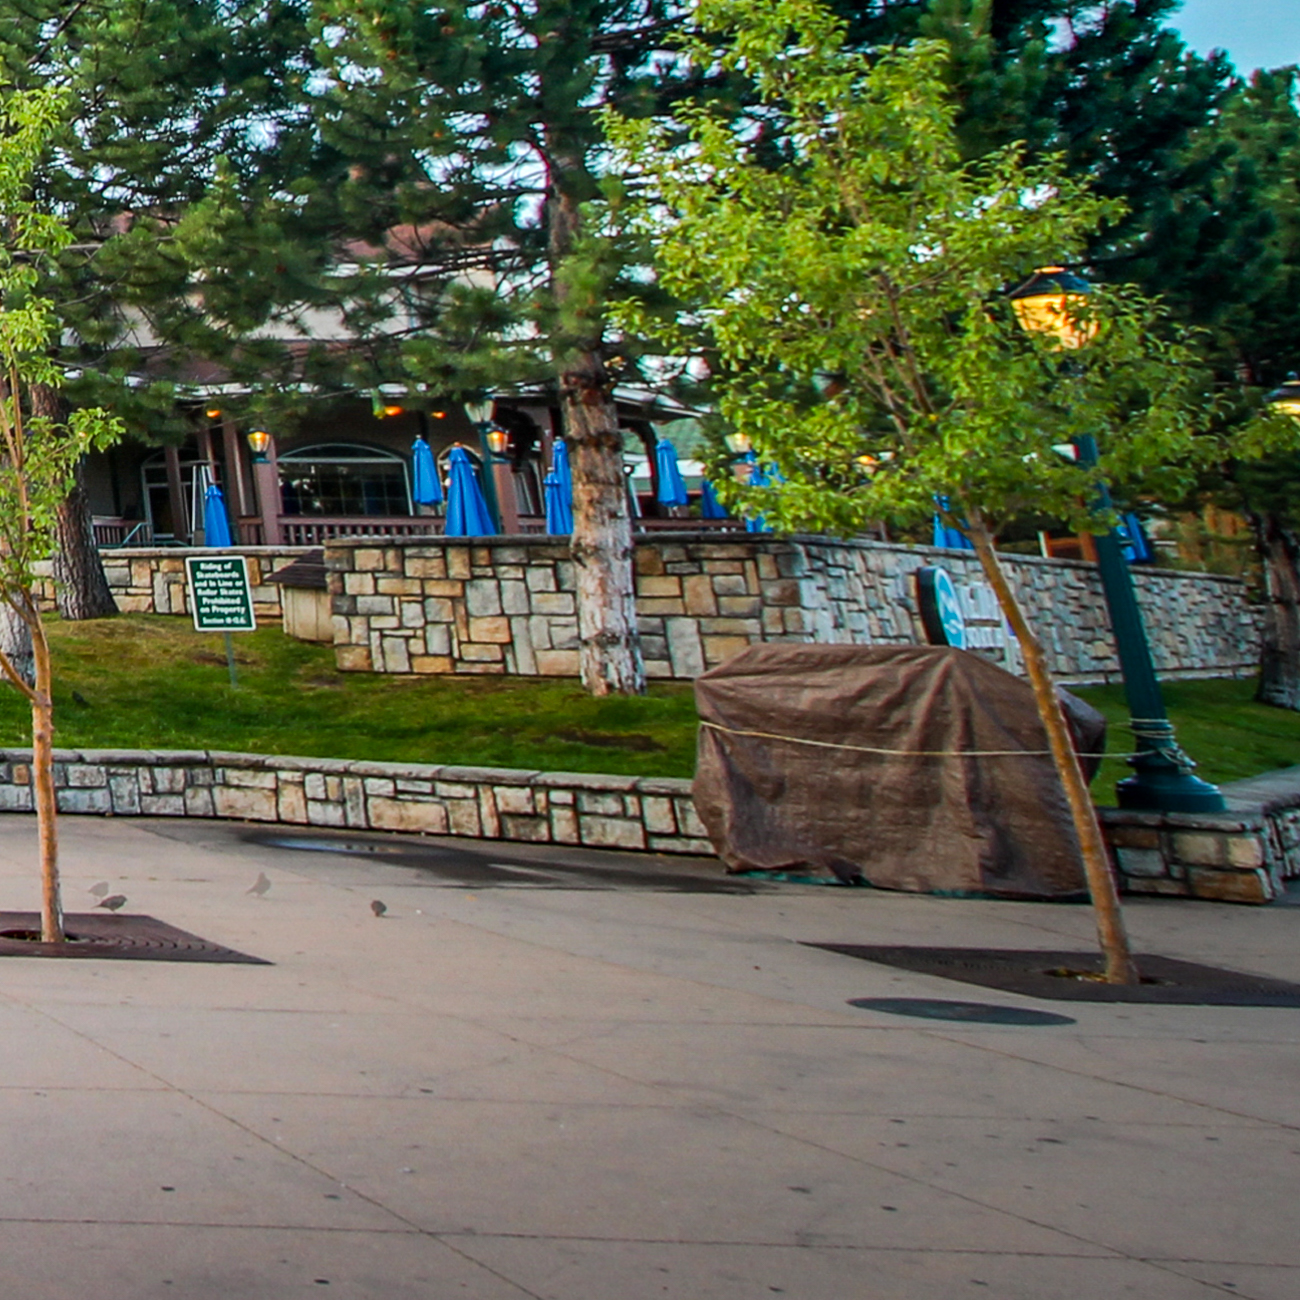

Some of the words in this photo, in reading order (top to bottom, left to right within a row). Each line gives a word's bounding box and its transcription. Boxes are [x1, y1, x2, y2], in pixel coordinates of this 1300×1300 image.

[200, 562, 222, 571] Riding
[196, 571, 239, 579] Skateboards
[194, 580, 208, 588] and
[197, 588, 218, 596] Roller
[202, 597, 241, 605] Prohibited
[212, 606, 246, 615] Property
